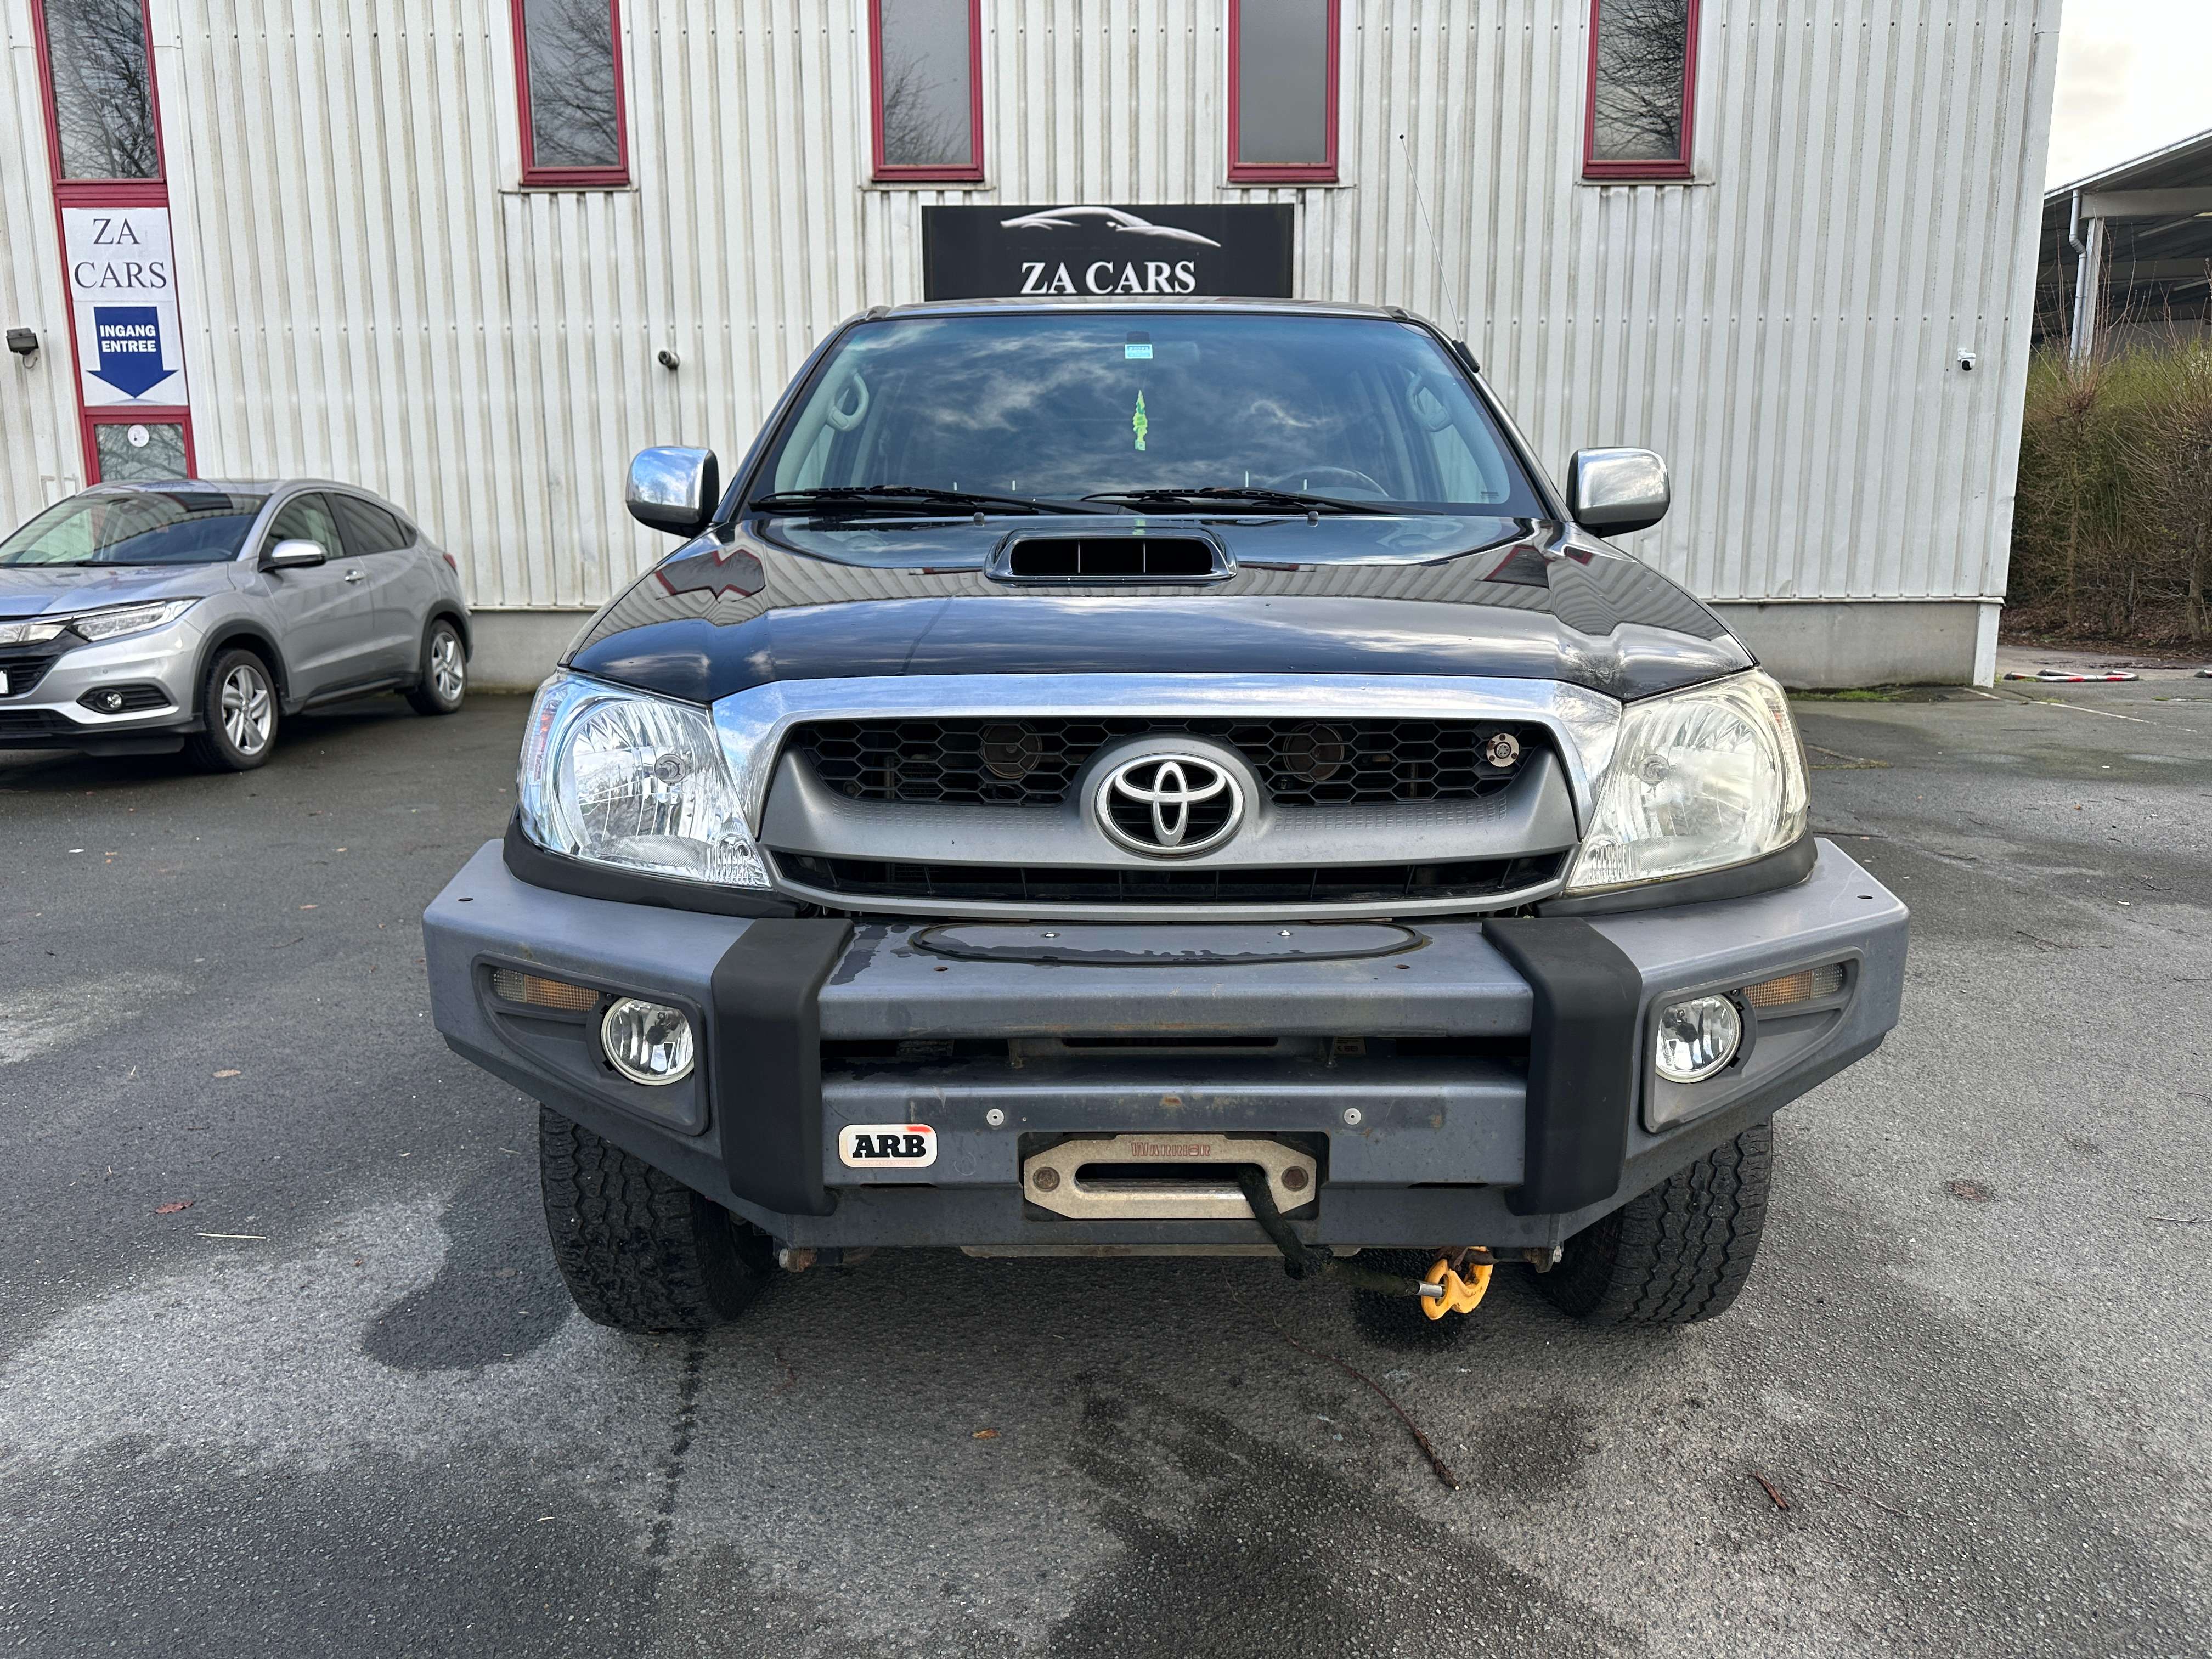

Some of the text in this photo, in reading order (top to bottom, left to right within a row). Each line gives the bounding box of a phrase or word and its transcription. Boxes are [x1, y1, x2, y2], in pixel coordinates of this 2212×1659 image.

[93, 218, 141, 245] ZA
[74, 261, 167, 289] CARS
[1020, 260, 1197, 295] ZA CARS
[99, 324, 156, 337] INGANG
[101, 340, 156, 353] ENTREE
[852, 1134, 927, 1158] ARB
[1131, 1142, 1211, 1156] WARRIOR
